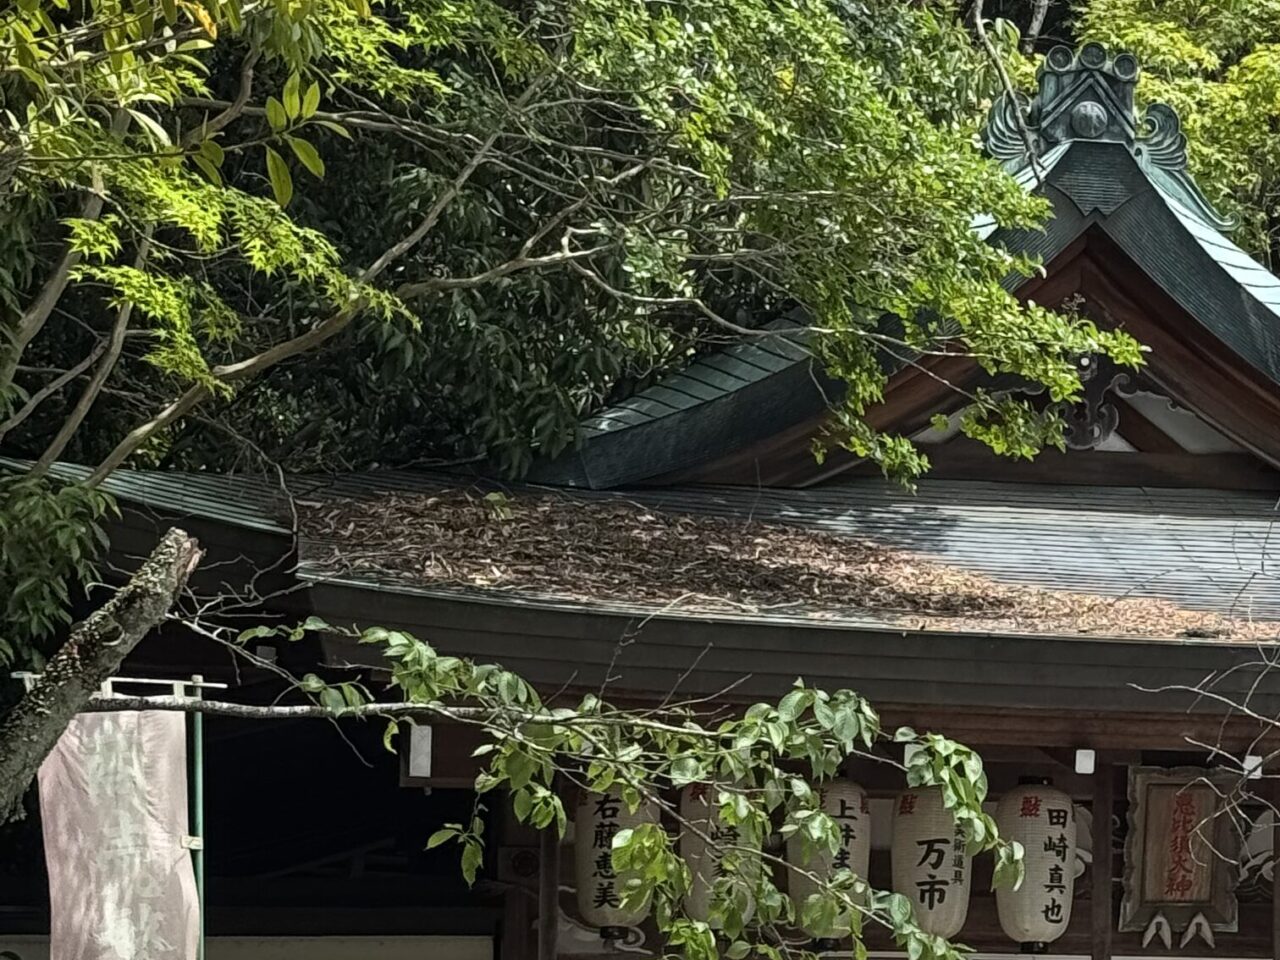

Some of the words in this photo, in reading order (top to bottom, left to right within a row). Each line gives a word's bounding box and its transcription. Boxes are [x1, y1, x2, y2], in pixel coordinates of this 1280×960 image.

[915, 838, 950, 910] 万市
[1041, 807, 1069, 925] 田崎真也
